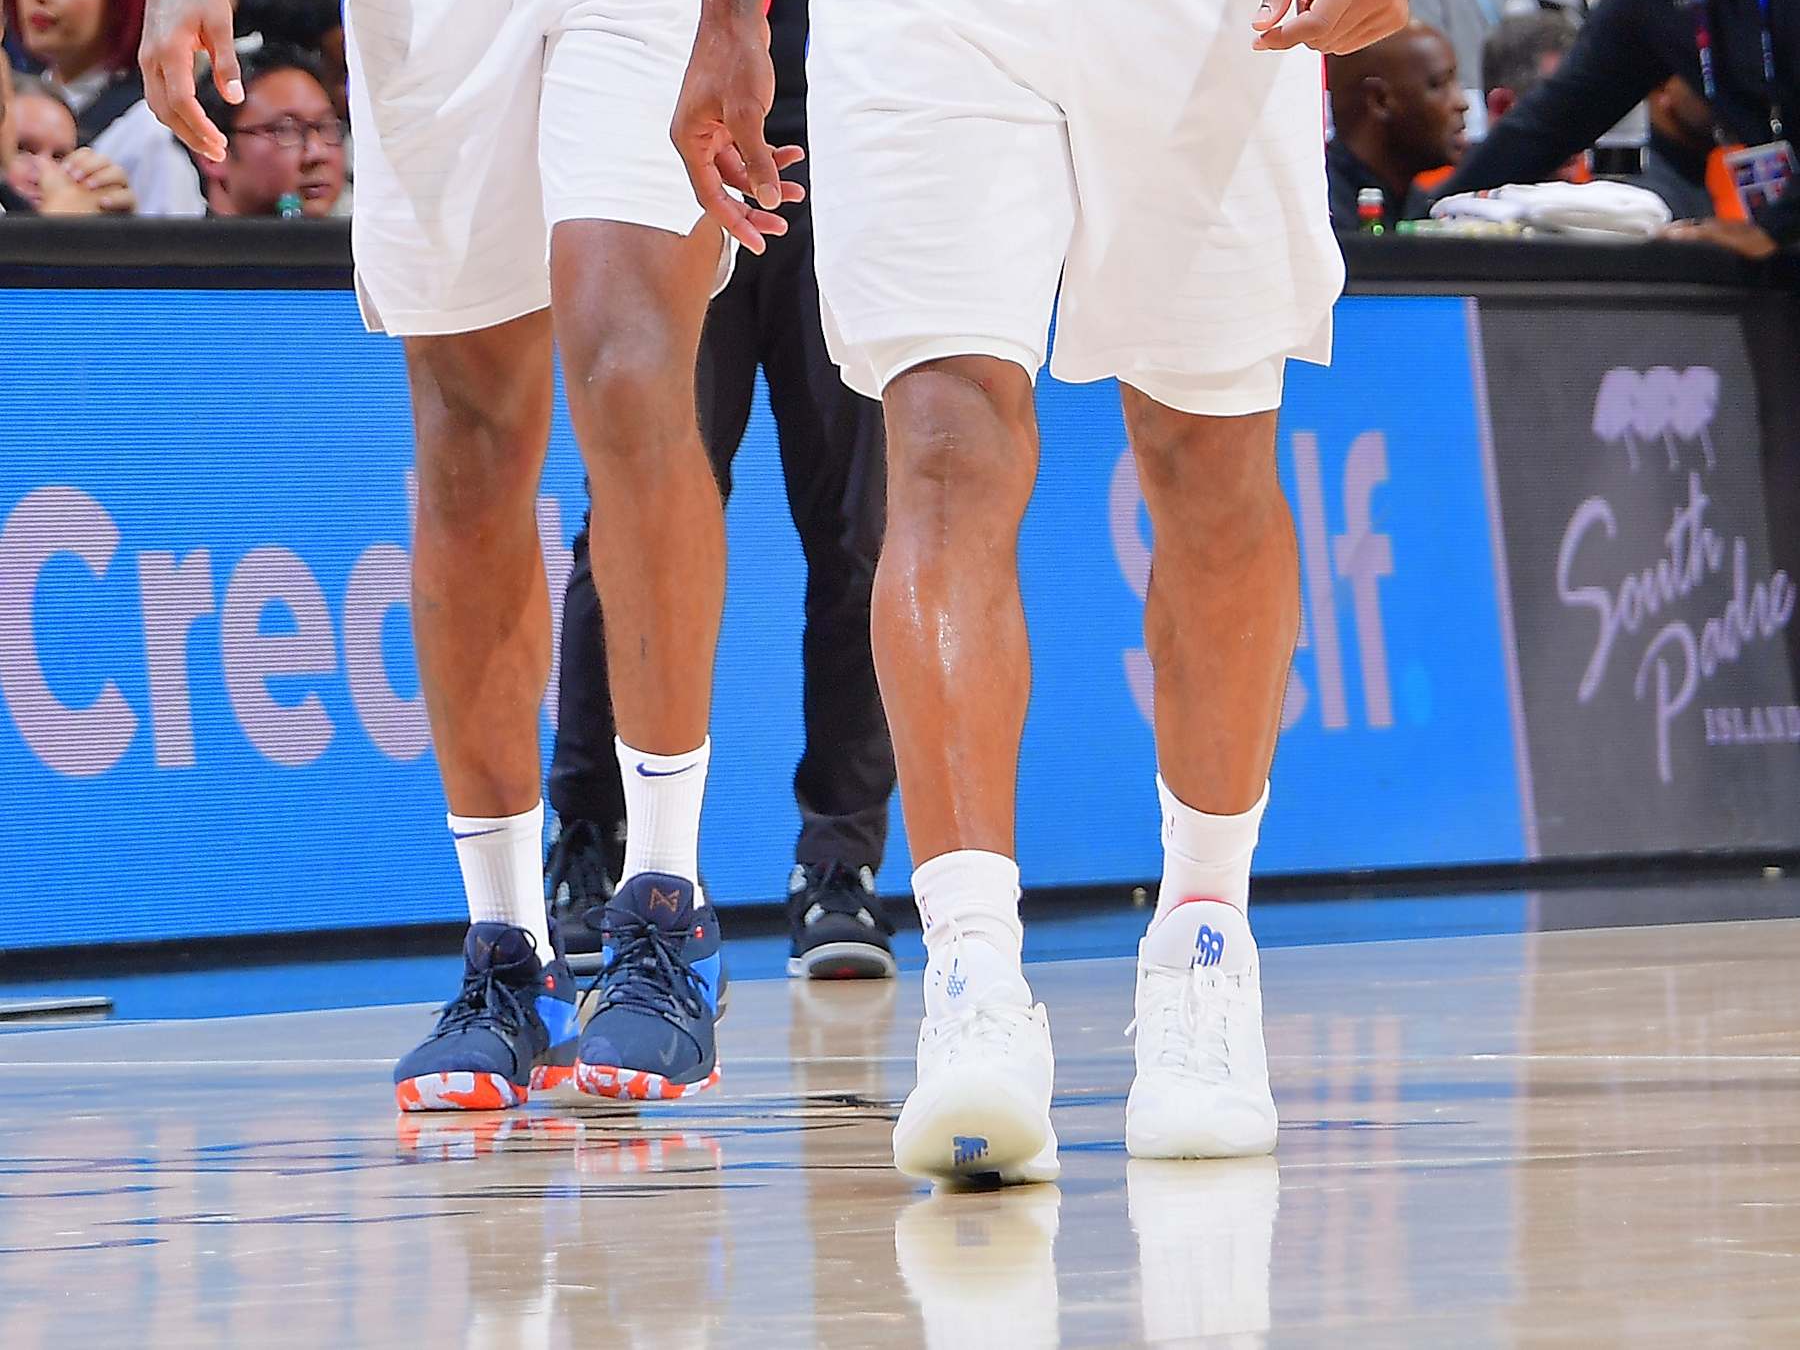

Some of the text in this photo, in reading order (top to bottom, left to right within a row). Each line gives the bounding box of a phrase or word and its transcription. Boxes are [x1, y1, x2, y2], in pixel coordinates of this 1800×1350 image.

[0, 470, 577, 777] Cred
[1556, 471, 1725, 705] South
[1633, 535, 1797, 784] Padre
